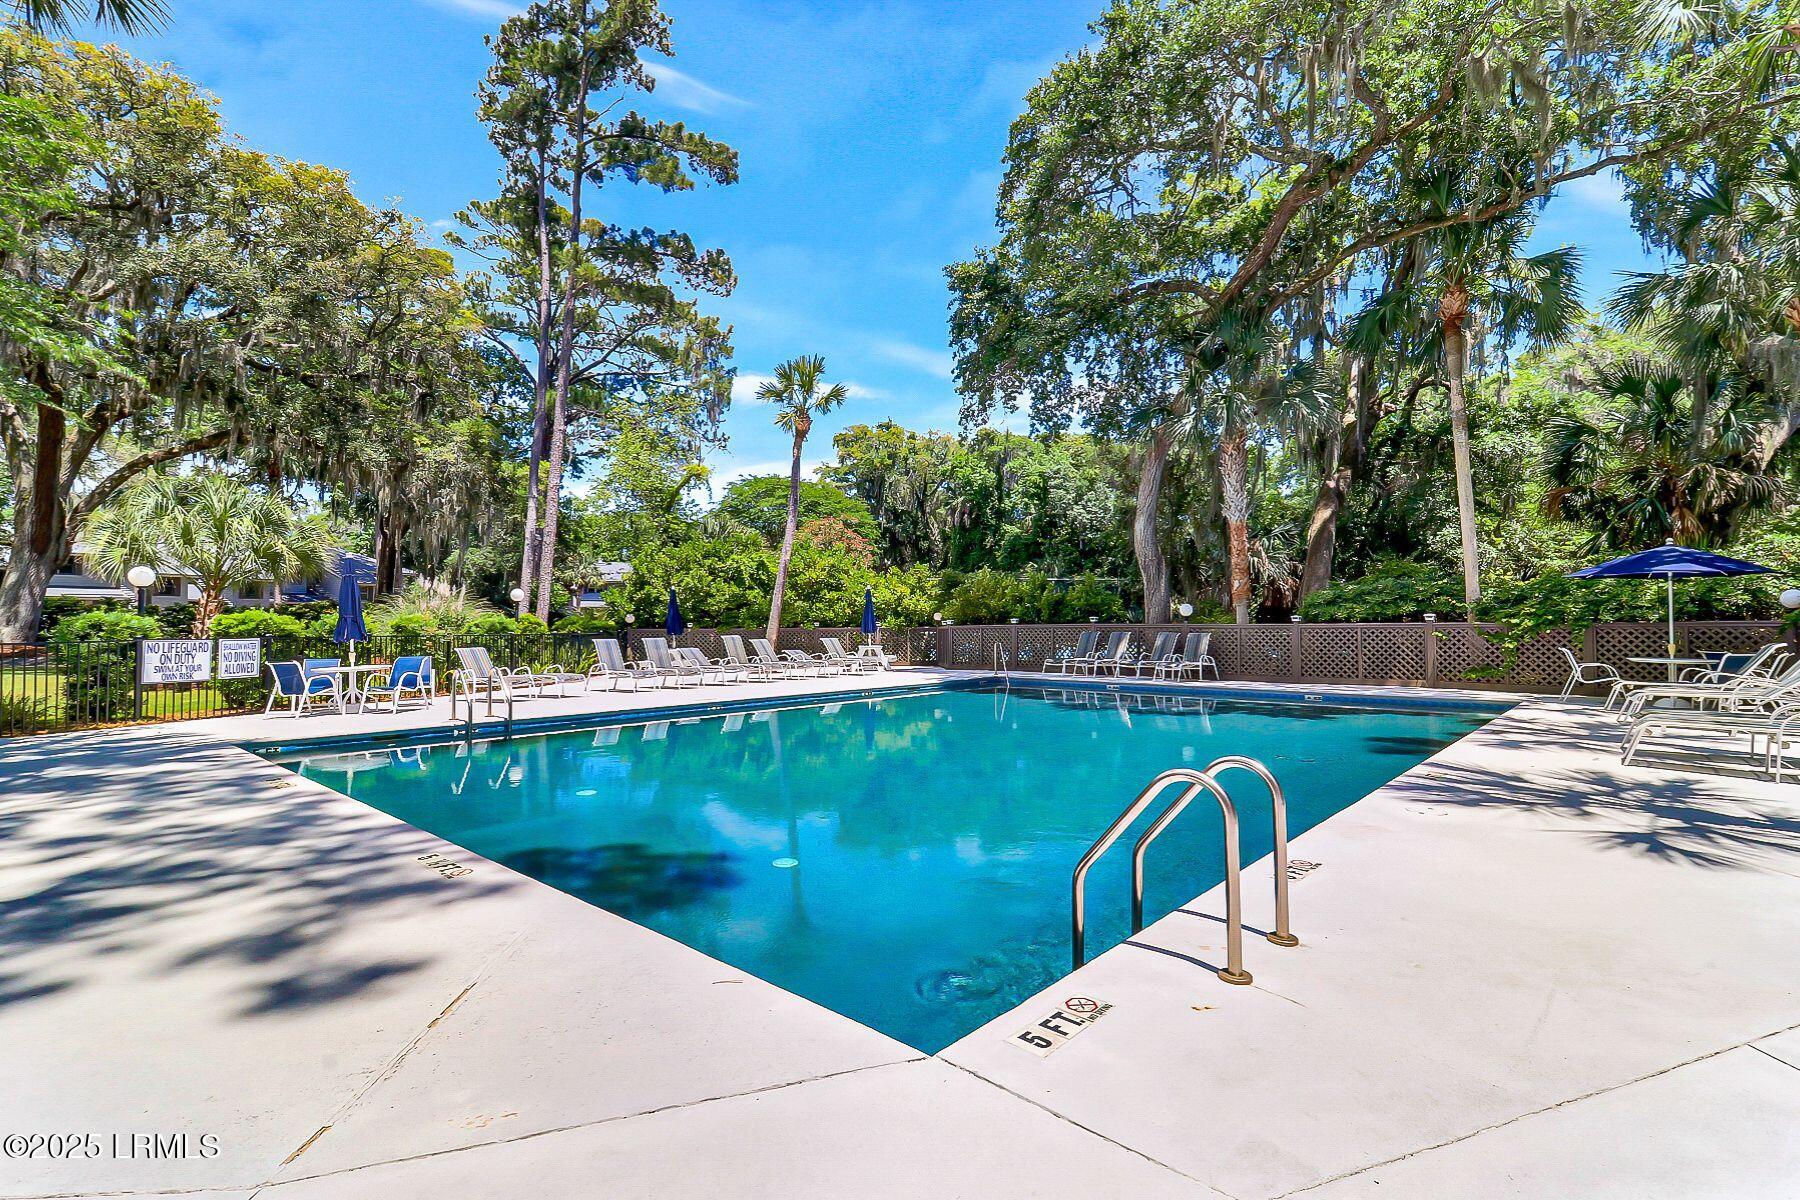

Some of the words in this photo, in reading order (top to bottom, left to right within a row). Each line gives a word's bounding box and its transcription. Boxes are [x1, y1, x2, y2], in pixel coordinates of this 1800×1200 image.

[146, 642, 160, 654] NO
[162, 641, 209, 654] LIFEGUARD
[223, 643, 243, 651] SHALLOW
[243, 642, 257, 650] WATER
[160, 654, 173, 665] ON
[174, 653, 196, 664] DUTY
[223, 652, 233, 663] NO
[234, 651, 256, 662] DIVING
[153, 665, 175, 674] SWIM
[175, 664, 183, 672] AT
[184, 664, 203, 672] YOUR
[224, 662, 255, 674] ALLOWED
[161, 673, 178, 681] OWN
[179, 672, 194, 680] RISK
[1016, 1030, 1053, 1049] 5
[1037, 1011, 1086, 1037] FT.
